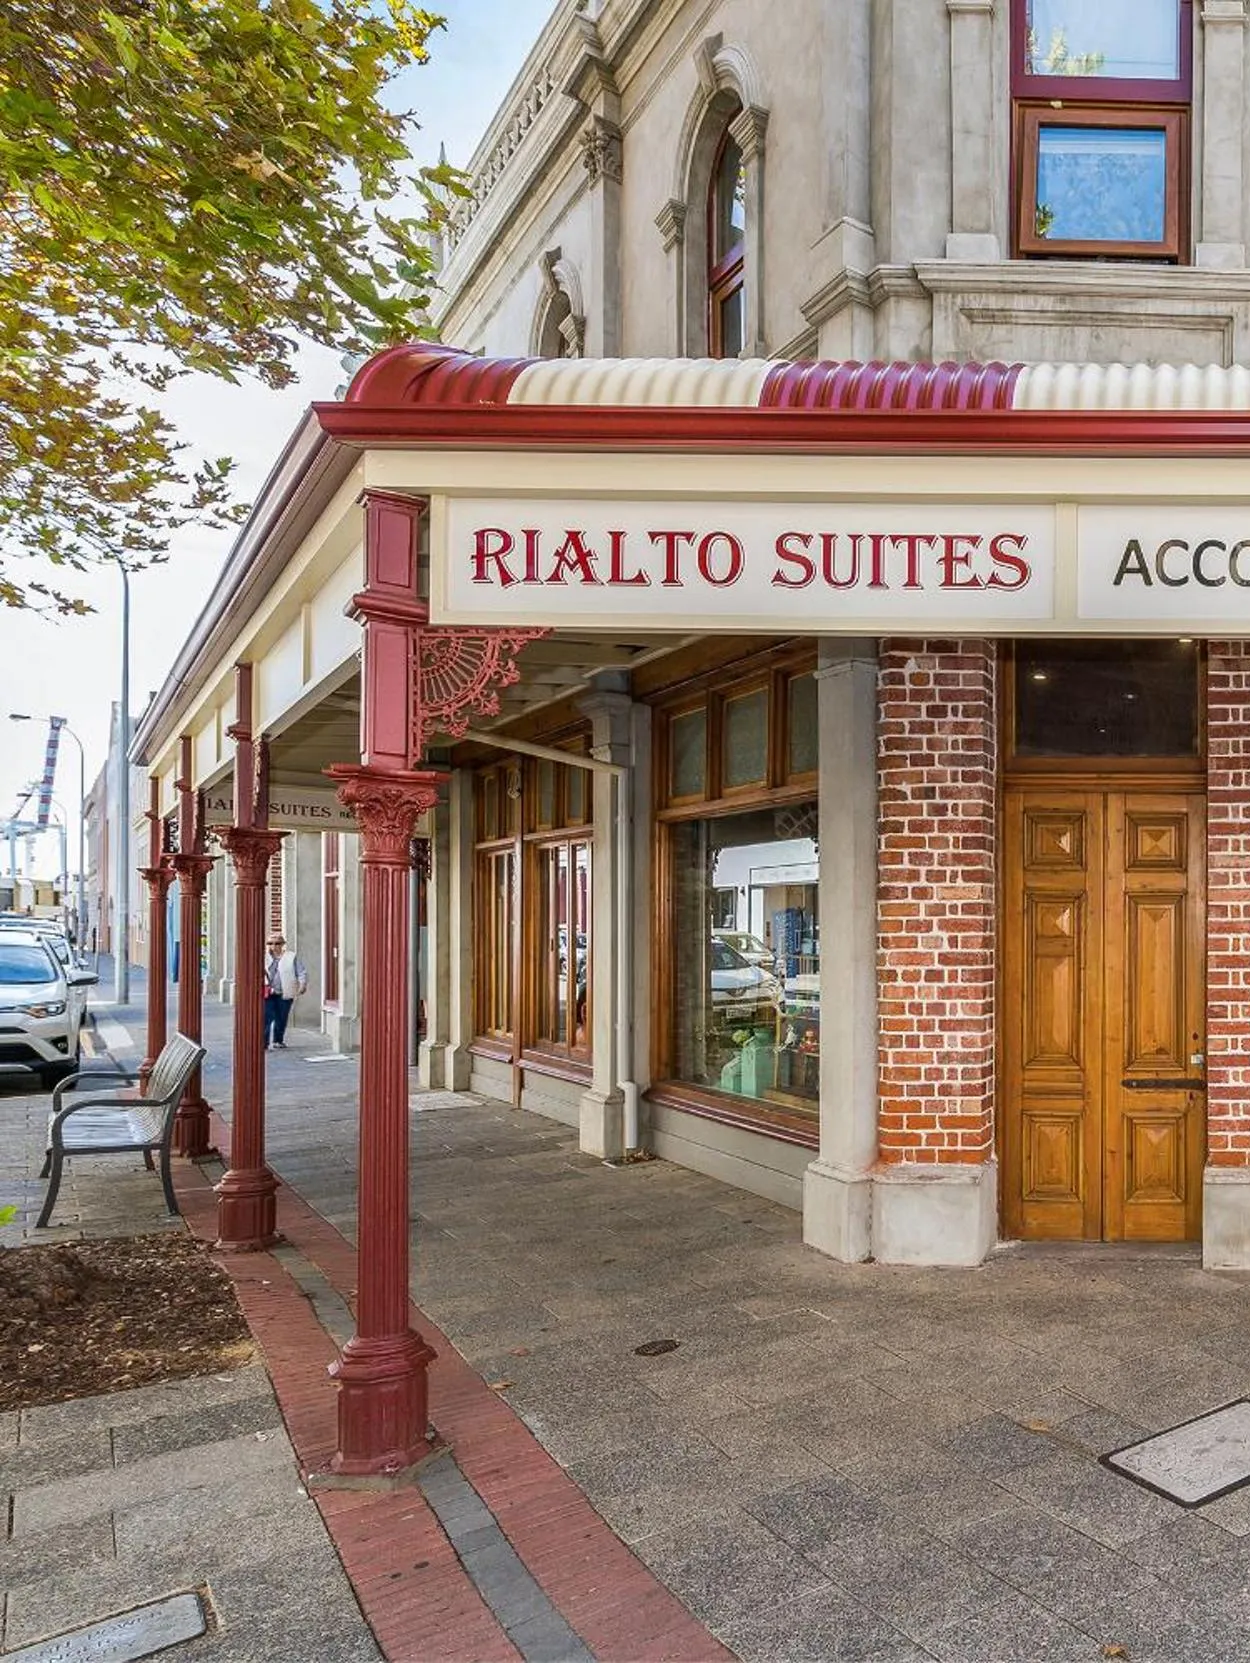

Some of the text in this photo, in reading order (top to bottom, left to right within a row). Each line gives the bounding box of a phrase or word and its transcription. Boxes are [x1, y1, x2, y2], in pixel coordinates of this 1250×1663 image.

[471, 526, 1032, 592] RIALTO SUITES
[269, 802, 332, 819] SUITES
